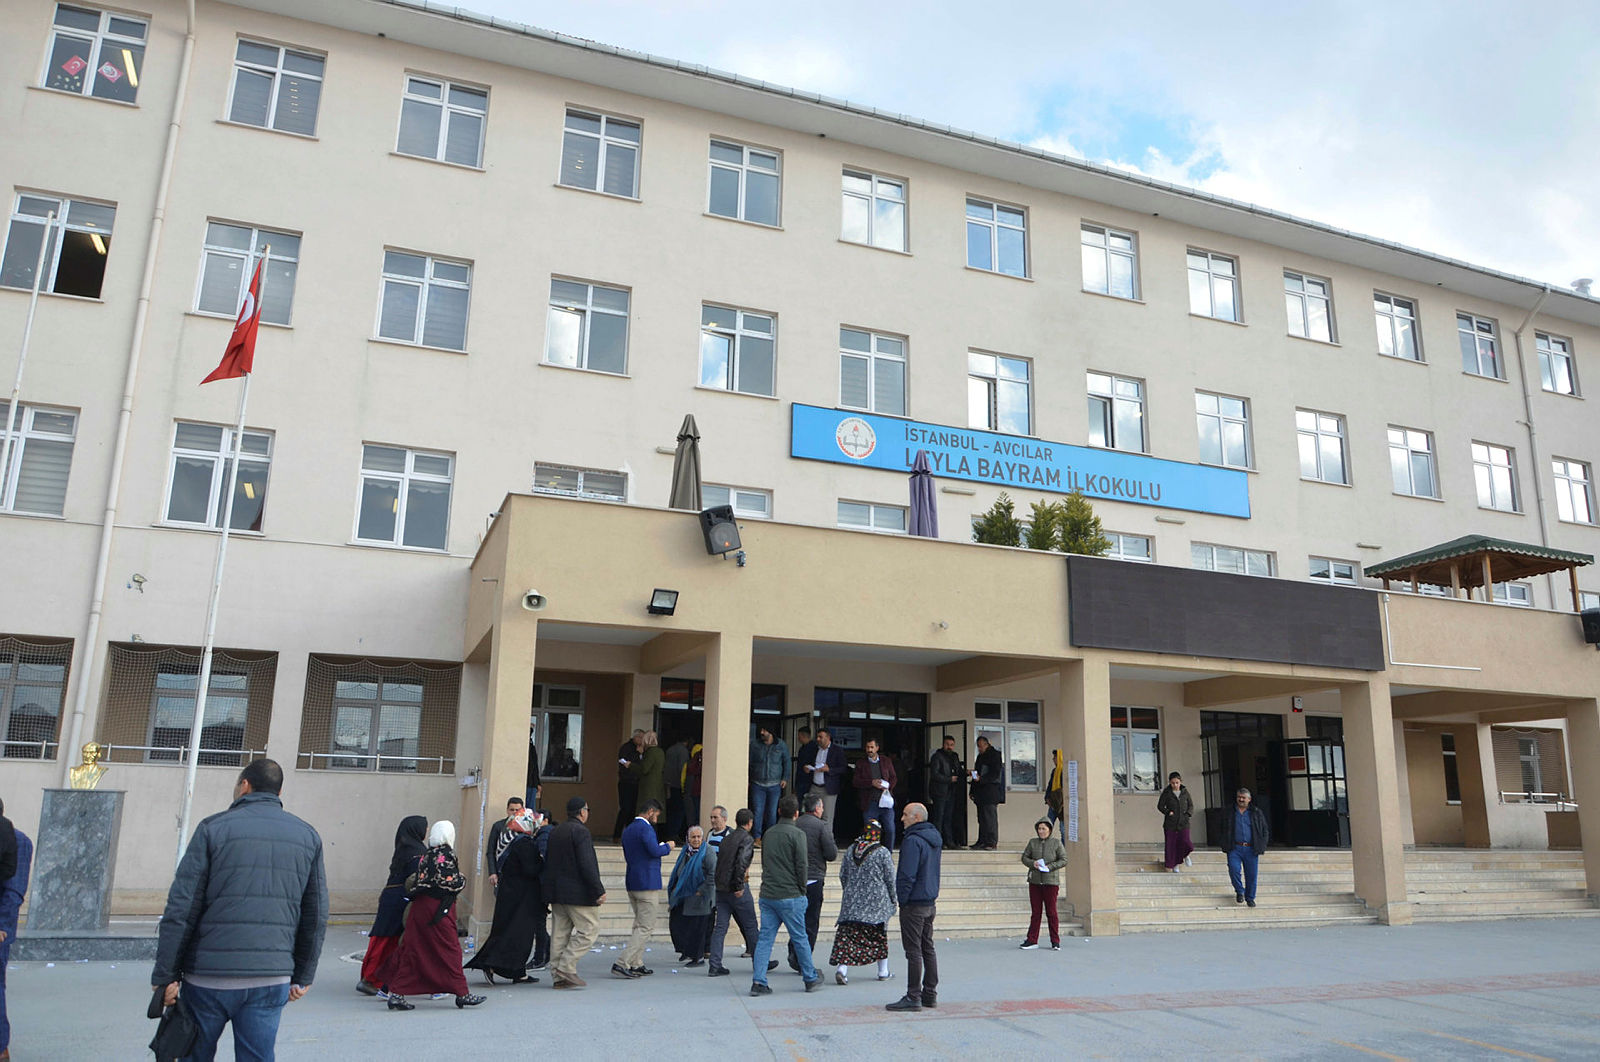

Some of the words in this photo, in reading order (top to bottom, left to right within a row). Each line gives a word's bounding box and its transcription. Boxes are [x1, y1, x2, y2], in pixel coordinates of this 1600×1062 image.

[905, 423, 979, 451] İSTANBUL
[993, 440, 1053, 462] AVCILAR
[905, 447, 971, 476] LYLA
[978, 458, 1061, 488] BAYRAM
[1067, 465, 1161, 502] İLKOKULU
